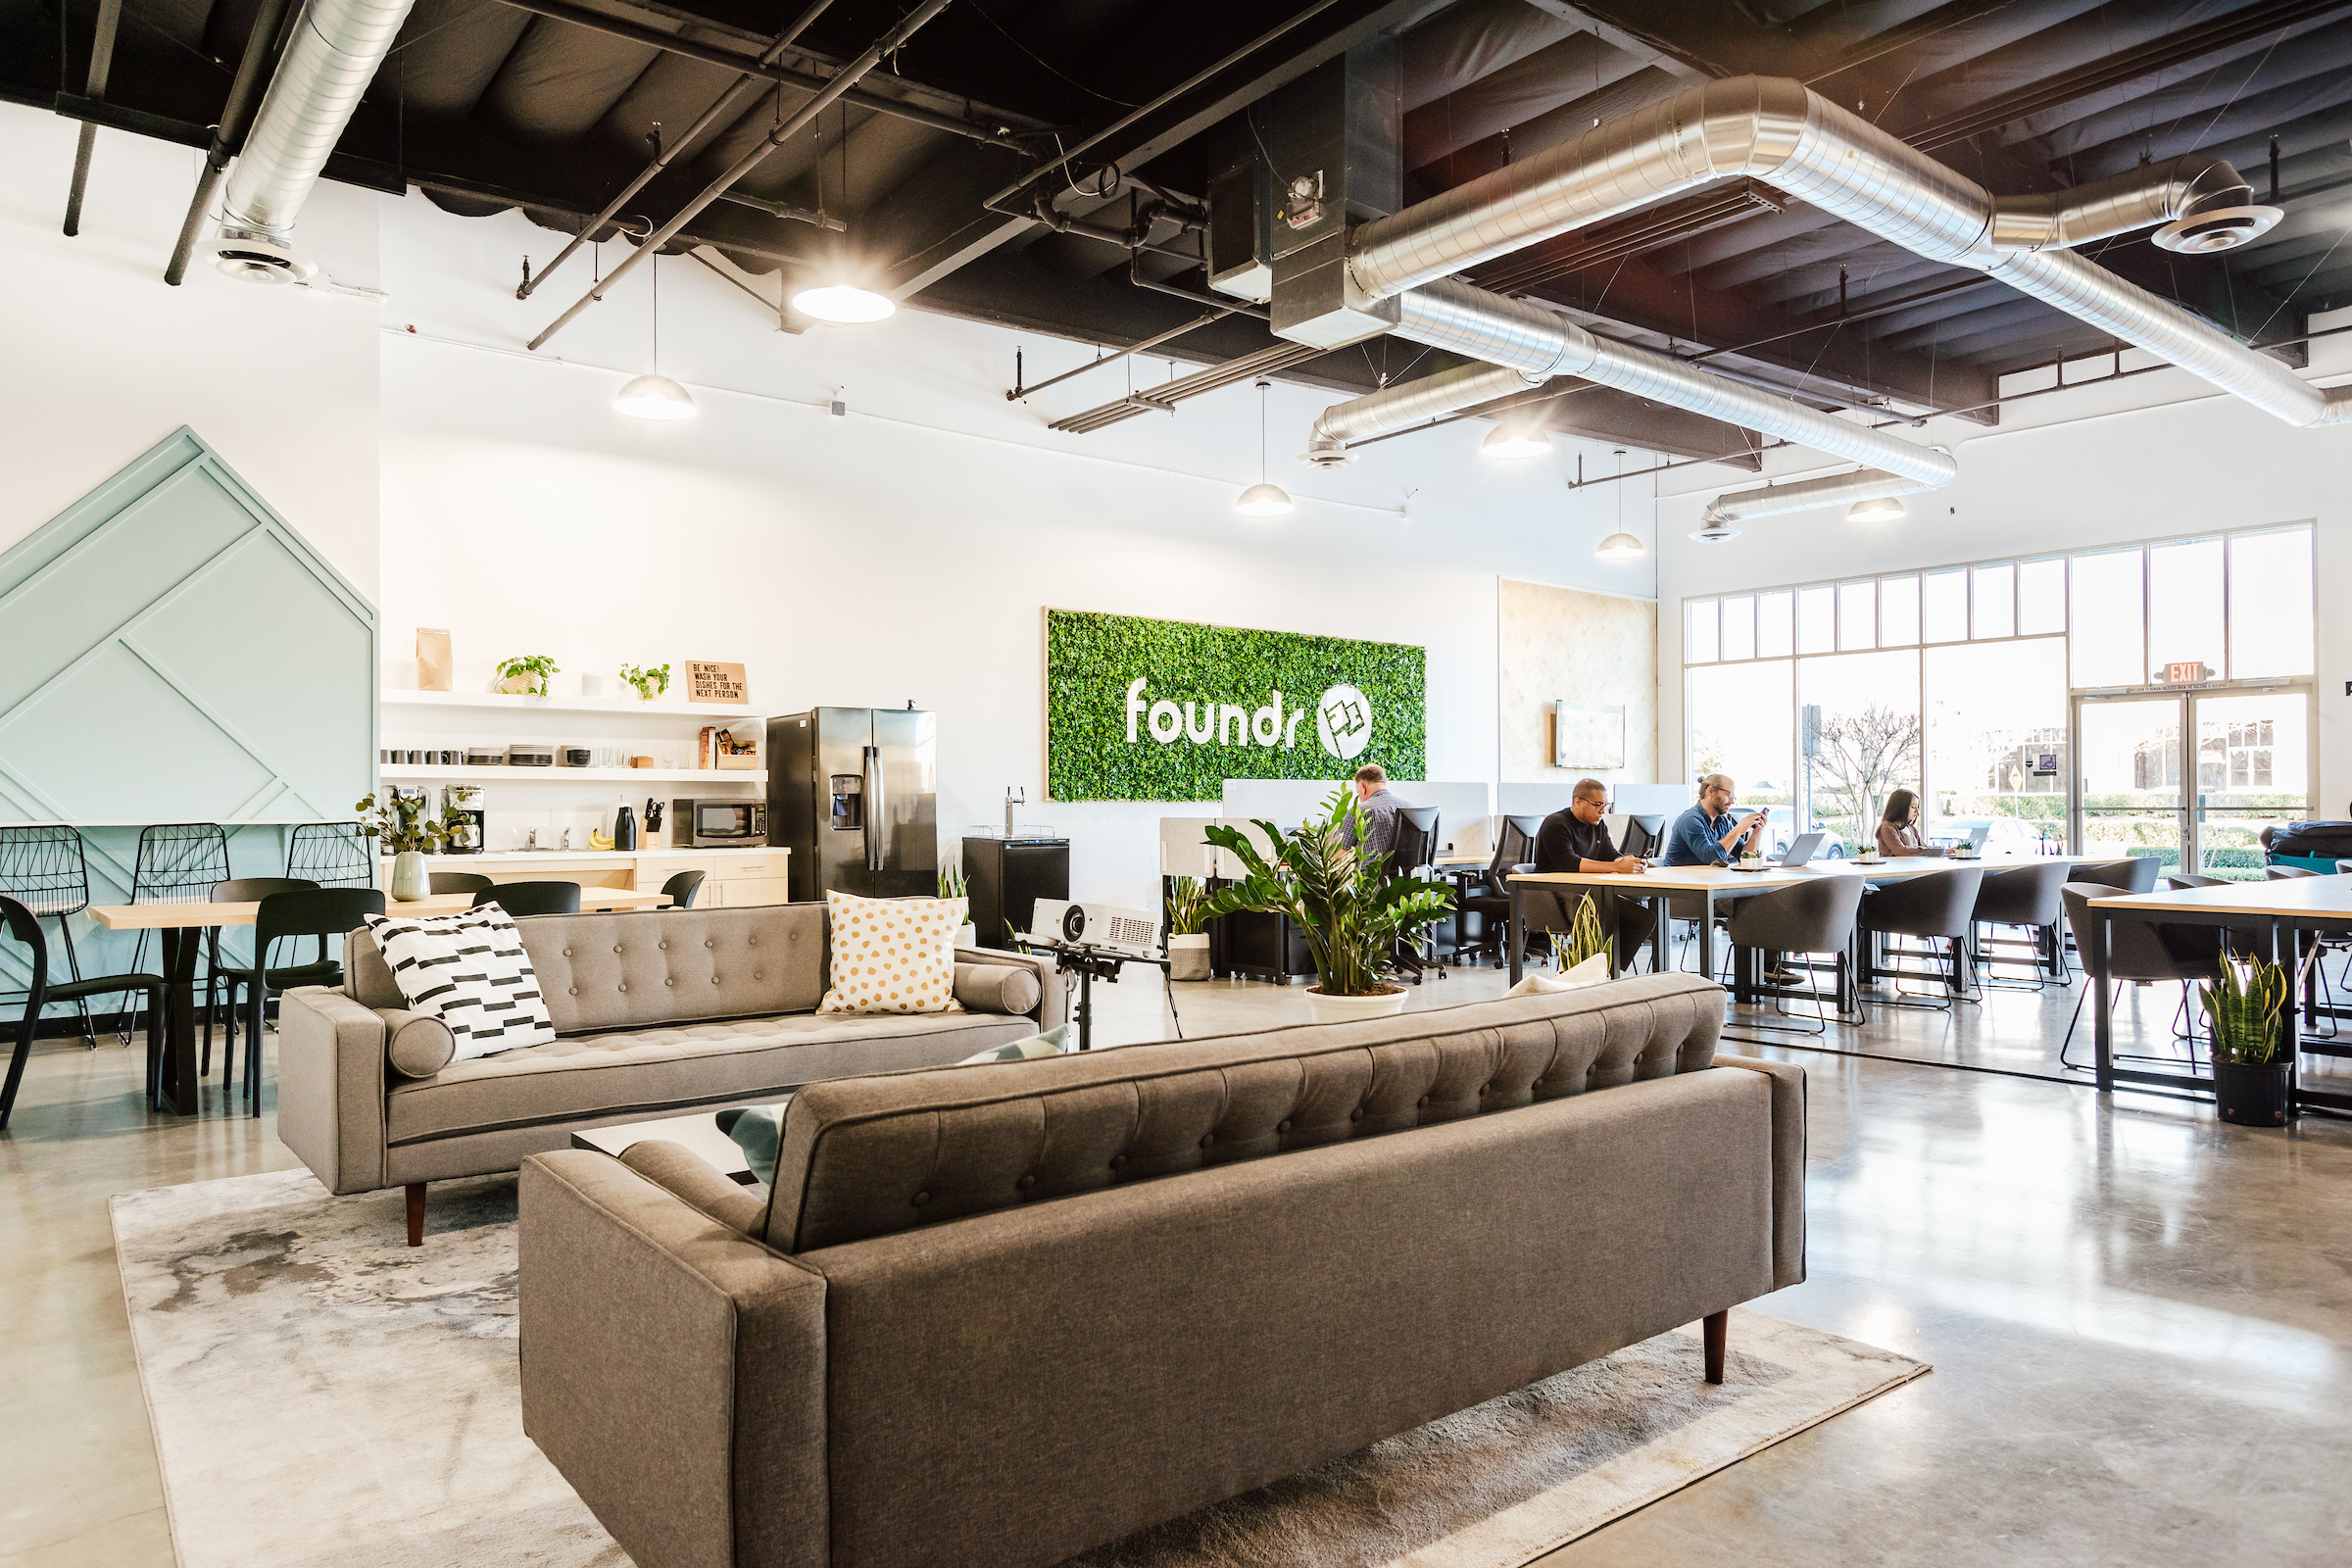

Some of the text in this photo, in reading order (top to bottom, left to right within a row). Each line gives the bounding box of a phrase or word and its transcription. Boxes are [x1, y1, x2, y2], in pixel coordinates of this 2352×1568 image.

[2170, 662, 2199, 683] EXIT
[696, 680, 716, 689] DISHES
[1126, 677, 1305, 748] foundr
